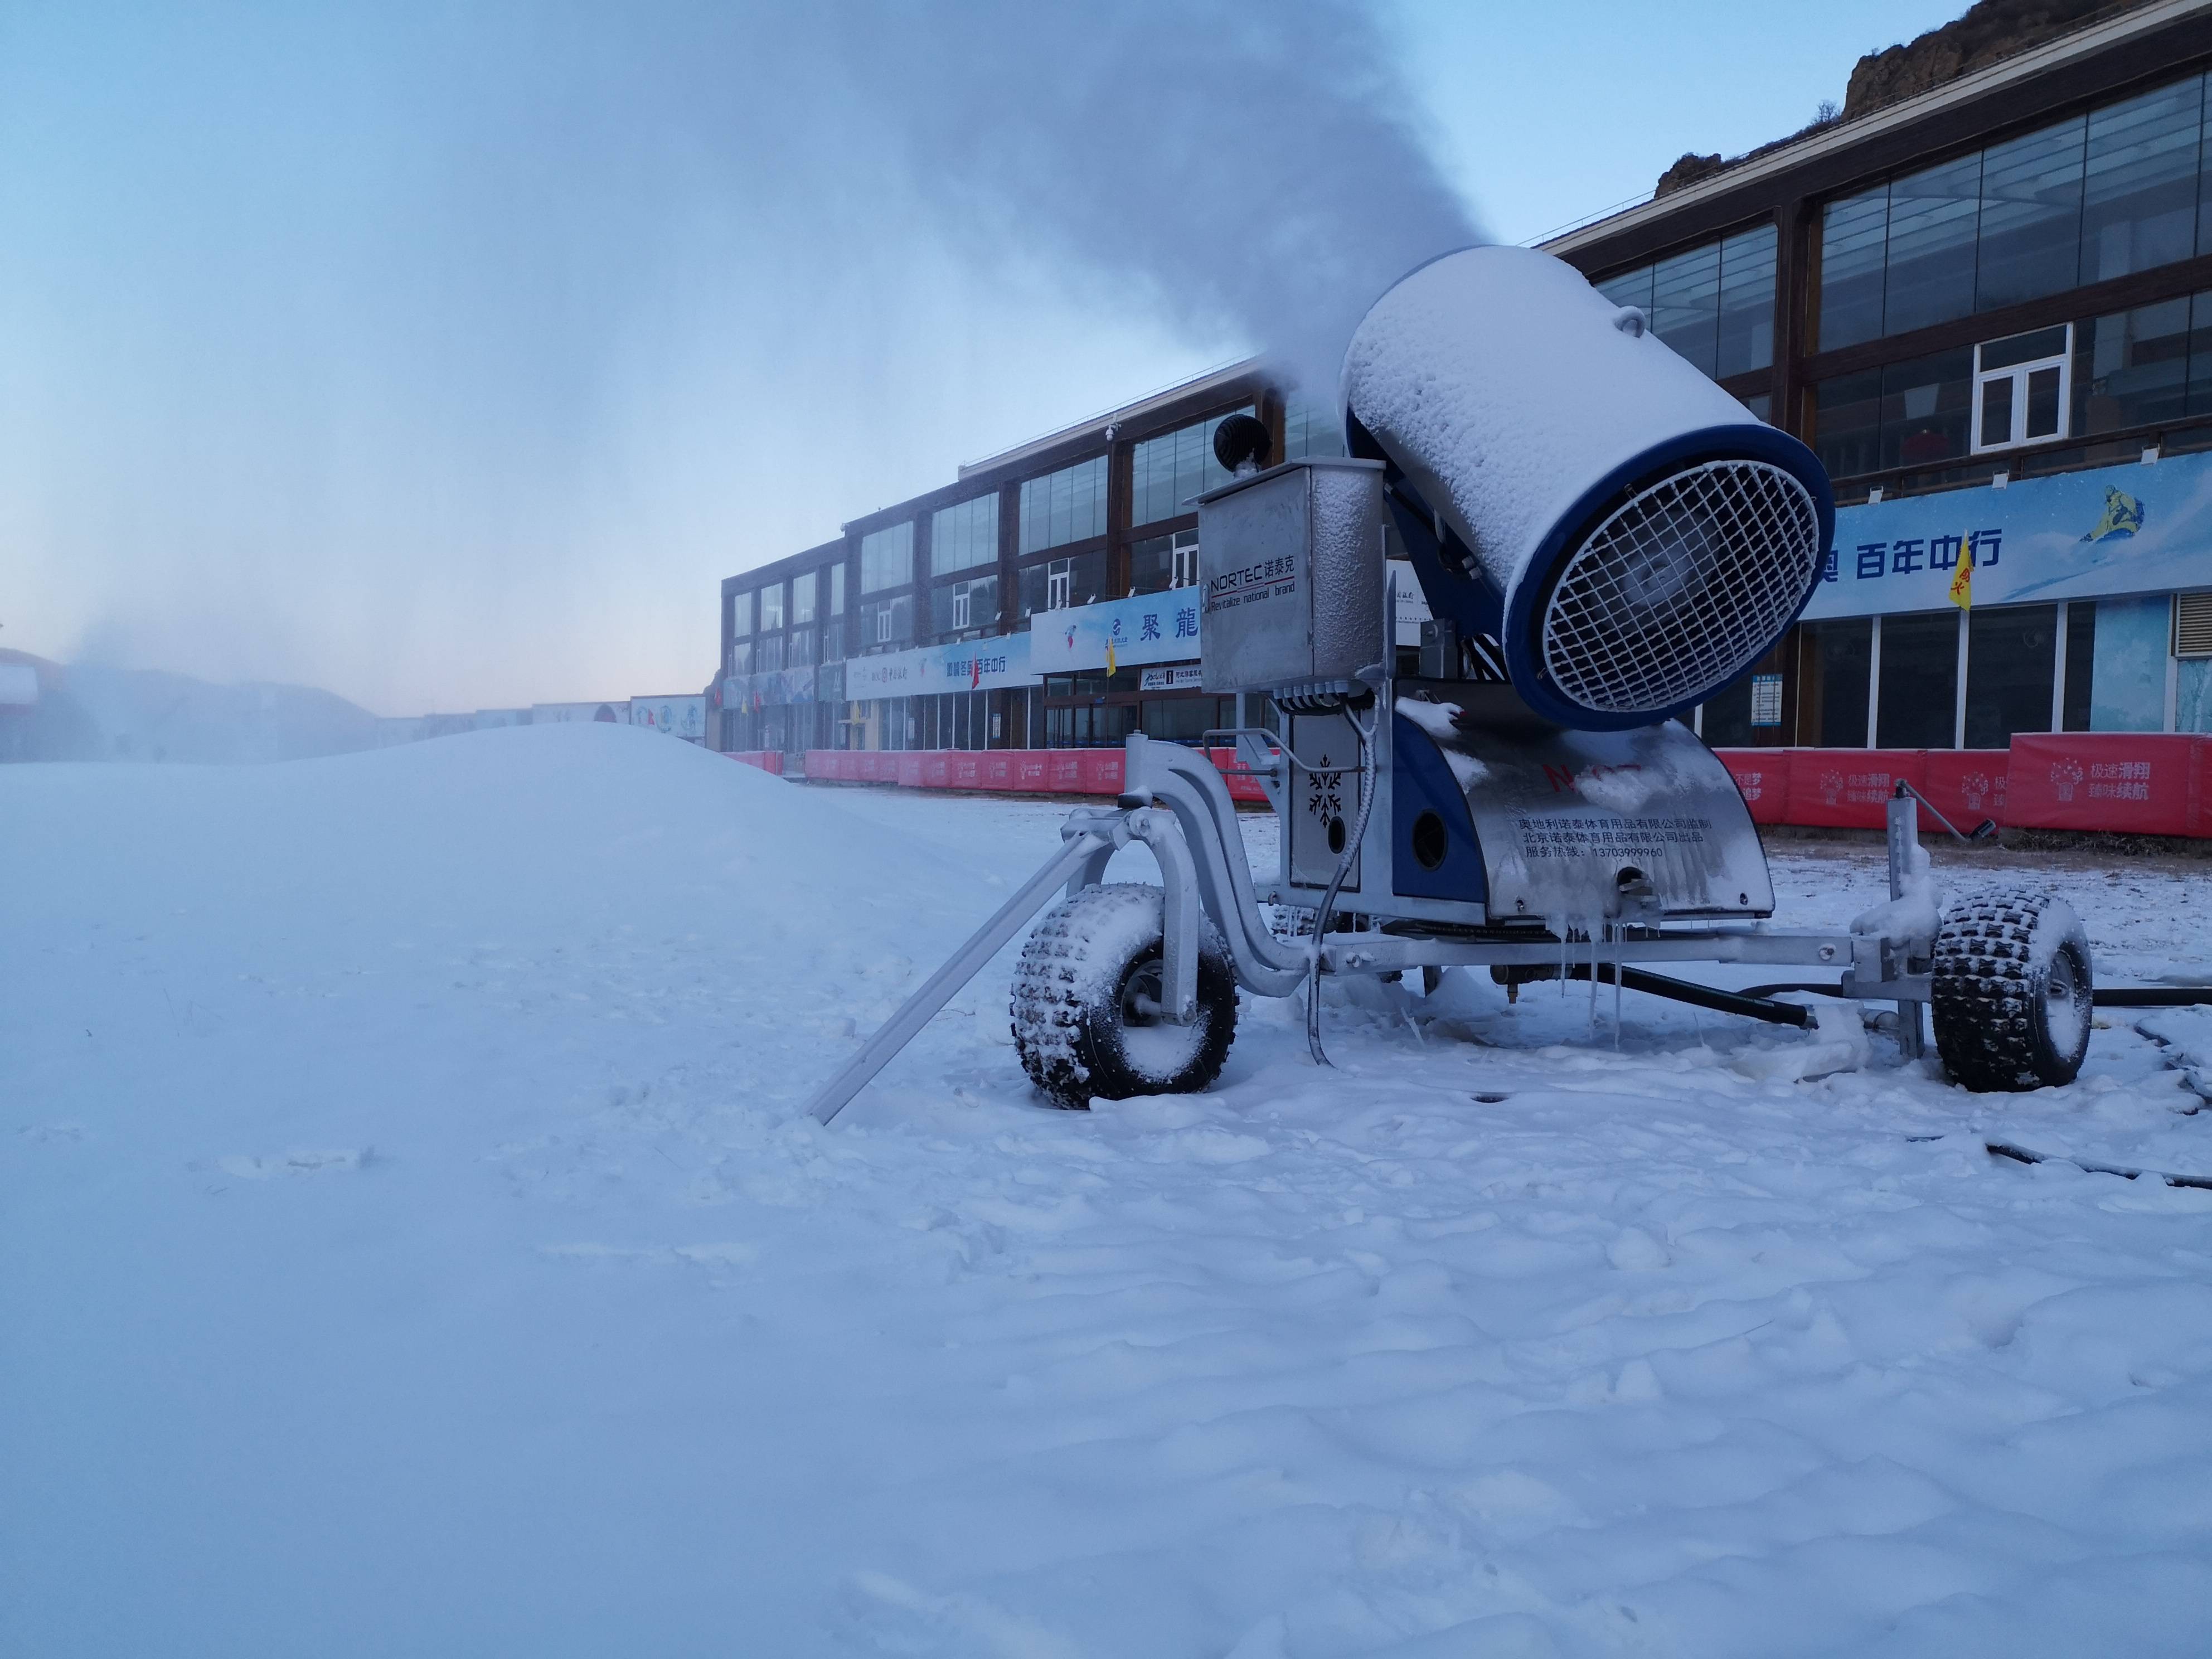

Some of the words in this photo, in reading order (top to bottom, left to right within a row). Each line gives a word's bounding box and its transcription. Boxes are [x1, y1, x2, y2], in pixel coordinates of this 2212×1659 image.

[1857, 528, 2002, 580] 百年中行
[1211, 565, 1262, 592] NORTEC
[1264, 555, 1294, 578] 诺泰克
[1211, 596, 1240, 612] Revitalize
[1244, 588, 1269, 603] national
[1275, 581, 1295, 596] brand
[947, 660, 973, 677] 冬奥
[1519, 818, 1712, 830] 奥地利诺泰体育用品有限公司监制
[1523, 832, 1704, 843] 北京诺泰体育用品有限公司出品
[1592, 847, 1663, 857] 13703999960
